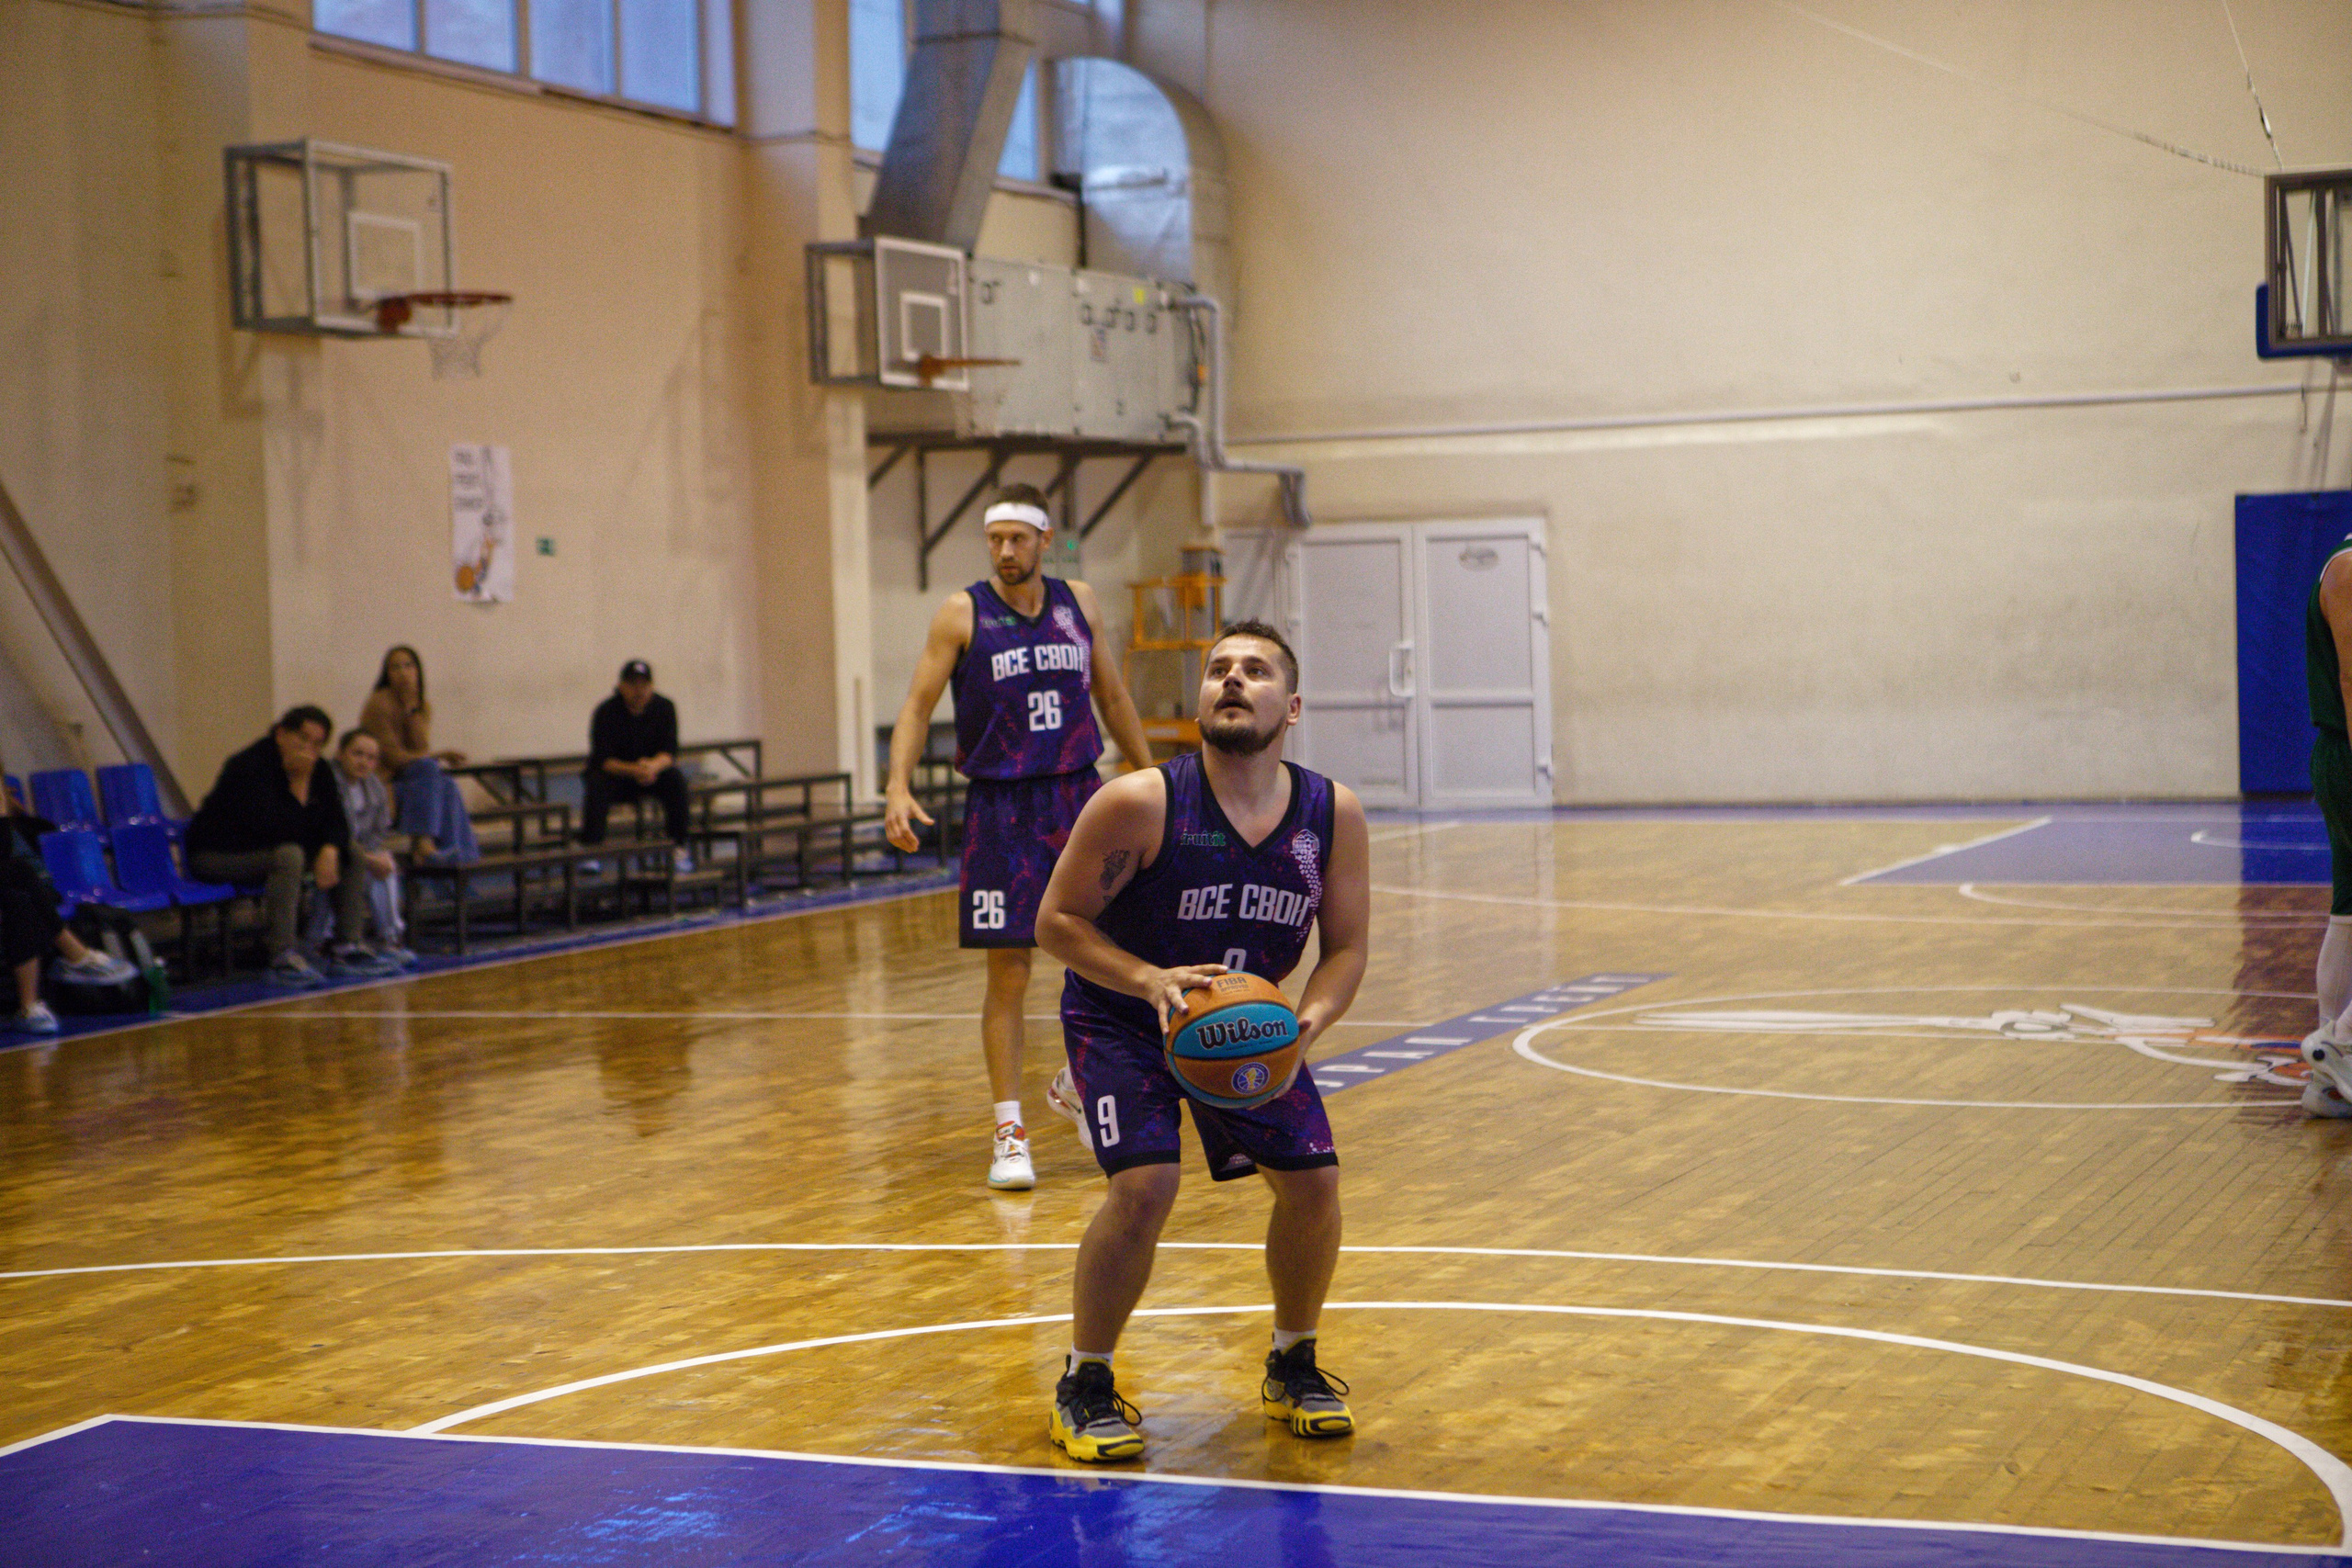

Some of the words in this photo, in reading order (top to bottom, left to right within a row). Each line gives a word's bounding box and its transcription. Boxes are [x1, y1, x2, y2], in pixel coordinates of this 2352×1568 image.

[991, 646, 1030, 682] ВСЕ
[1027, 690, 1061, 731] 26
[972, 890, 1006, 930] 26
[1177, 884, 1233, 920] ВСЕ
[1238, 884, 1311, 927] СВОИ
[1216, 976, 1247, 988] FIBA
[1195, 1017, 1288, 1050] Wilson
[1097, 1095, 1120, 1148] 9
